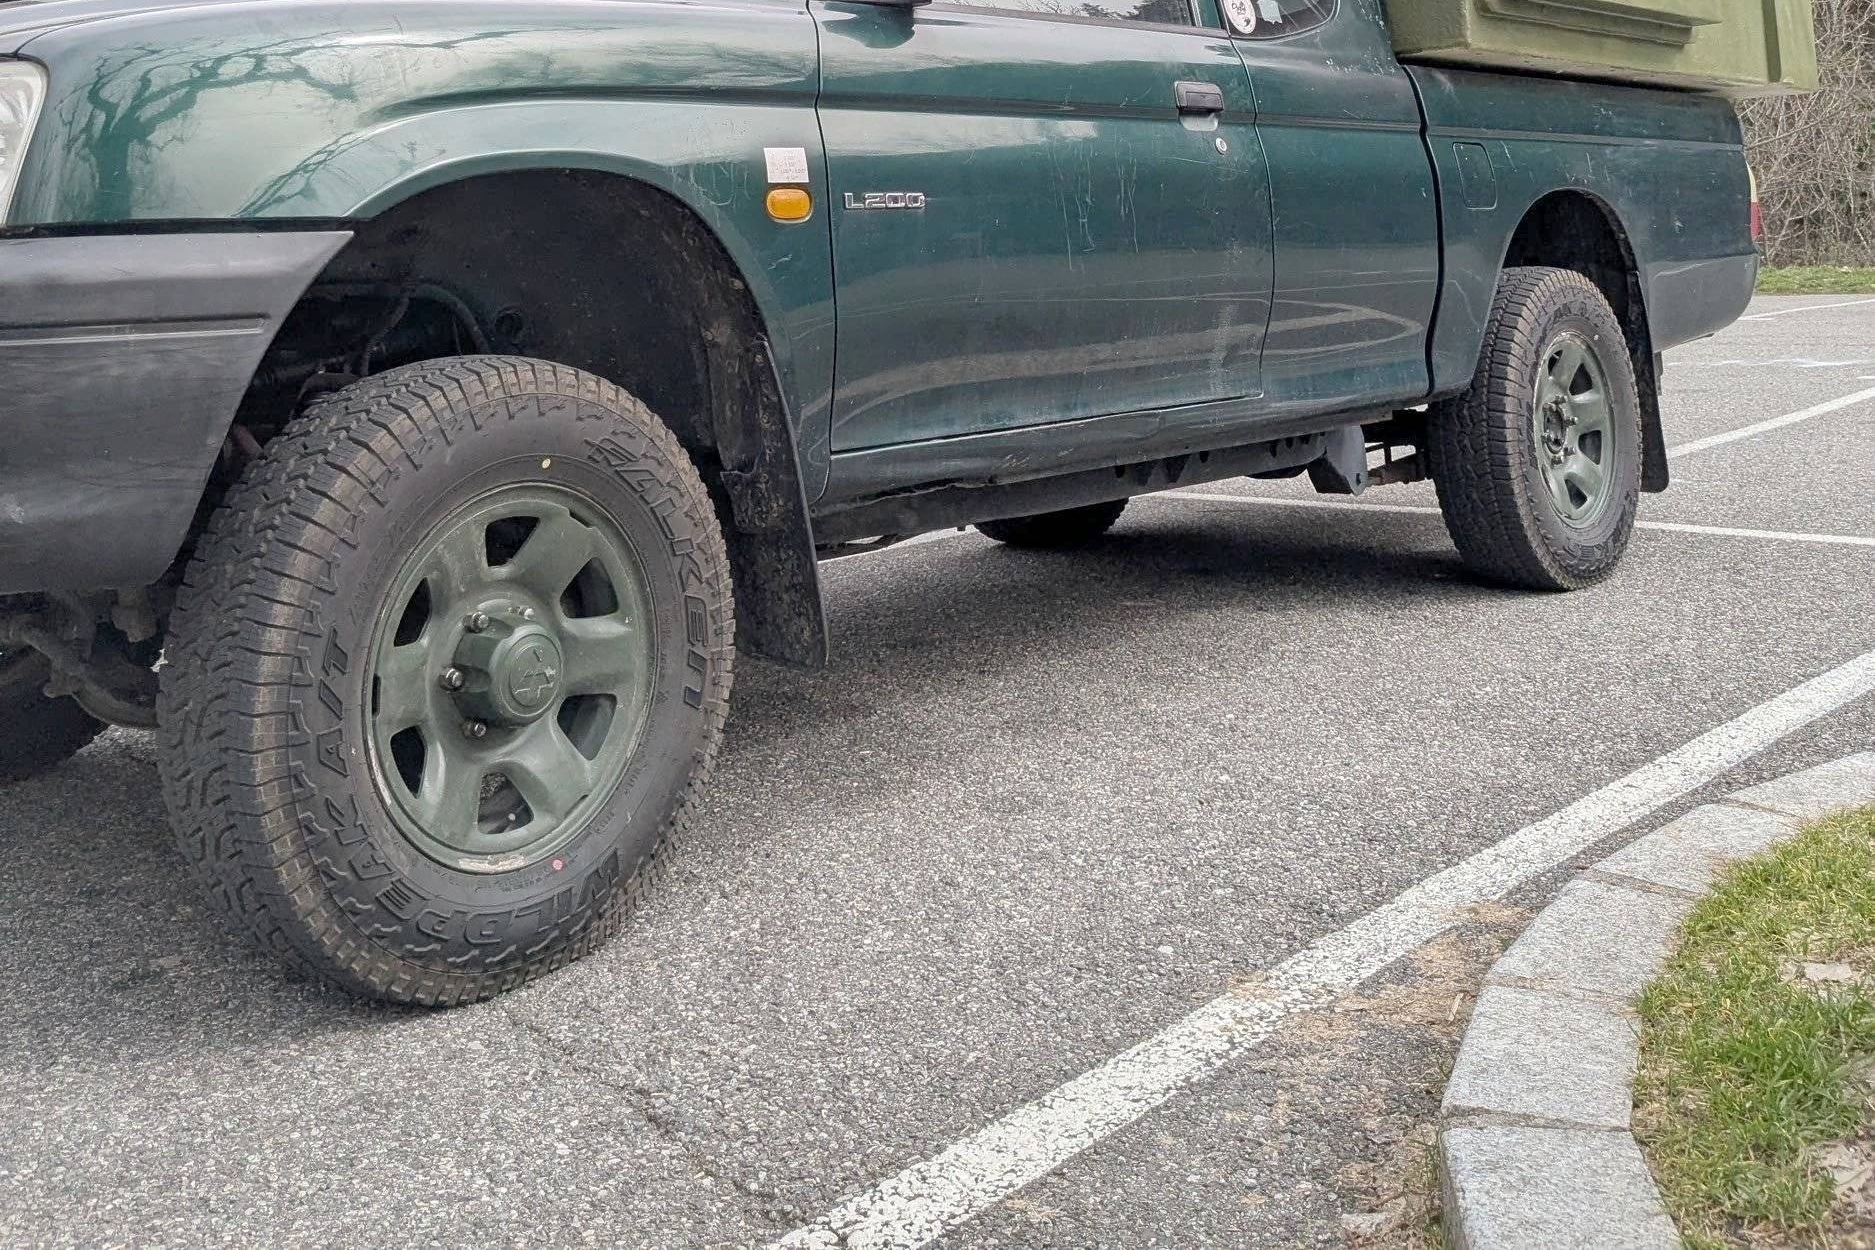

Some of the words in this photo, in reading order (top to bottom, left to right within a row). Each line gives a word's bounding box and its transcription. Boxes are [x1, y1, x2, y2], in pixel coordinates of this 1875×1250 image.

[844, 192, 926, 209] L200
[584, 437, 709, 710] FALKEN
[326, 796, 620, 945] WILDPEAK
